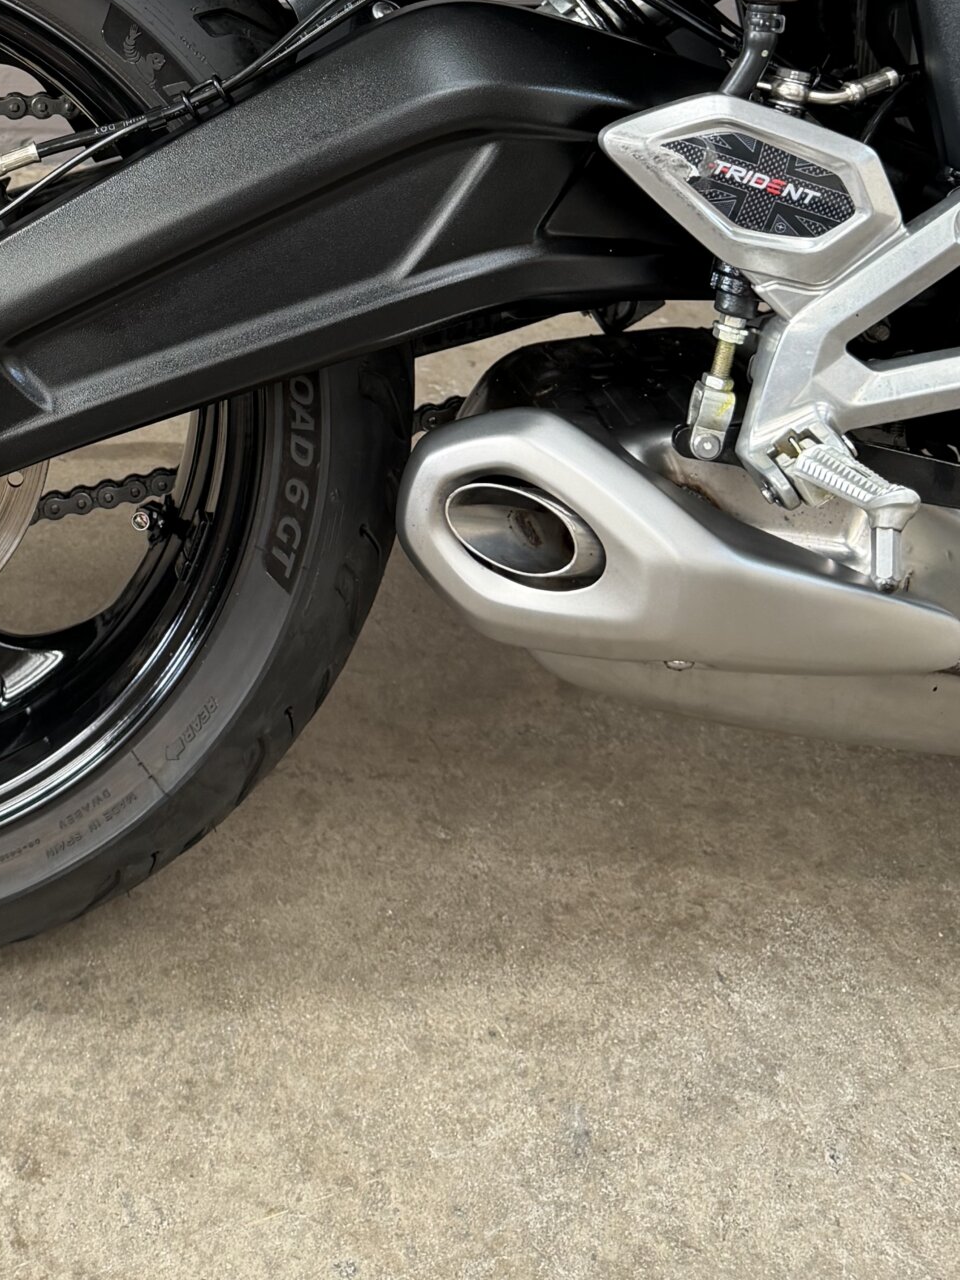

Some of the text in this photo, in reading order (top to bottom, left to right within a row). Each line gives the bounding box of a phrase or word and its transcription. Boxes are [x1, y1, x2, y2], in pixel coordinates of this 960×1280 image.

[713, 159, 821, 204] TRIDENT
[272, 376, 315, 579] OAD 6 GT
[181, 696, 219, 742] REAR
